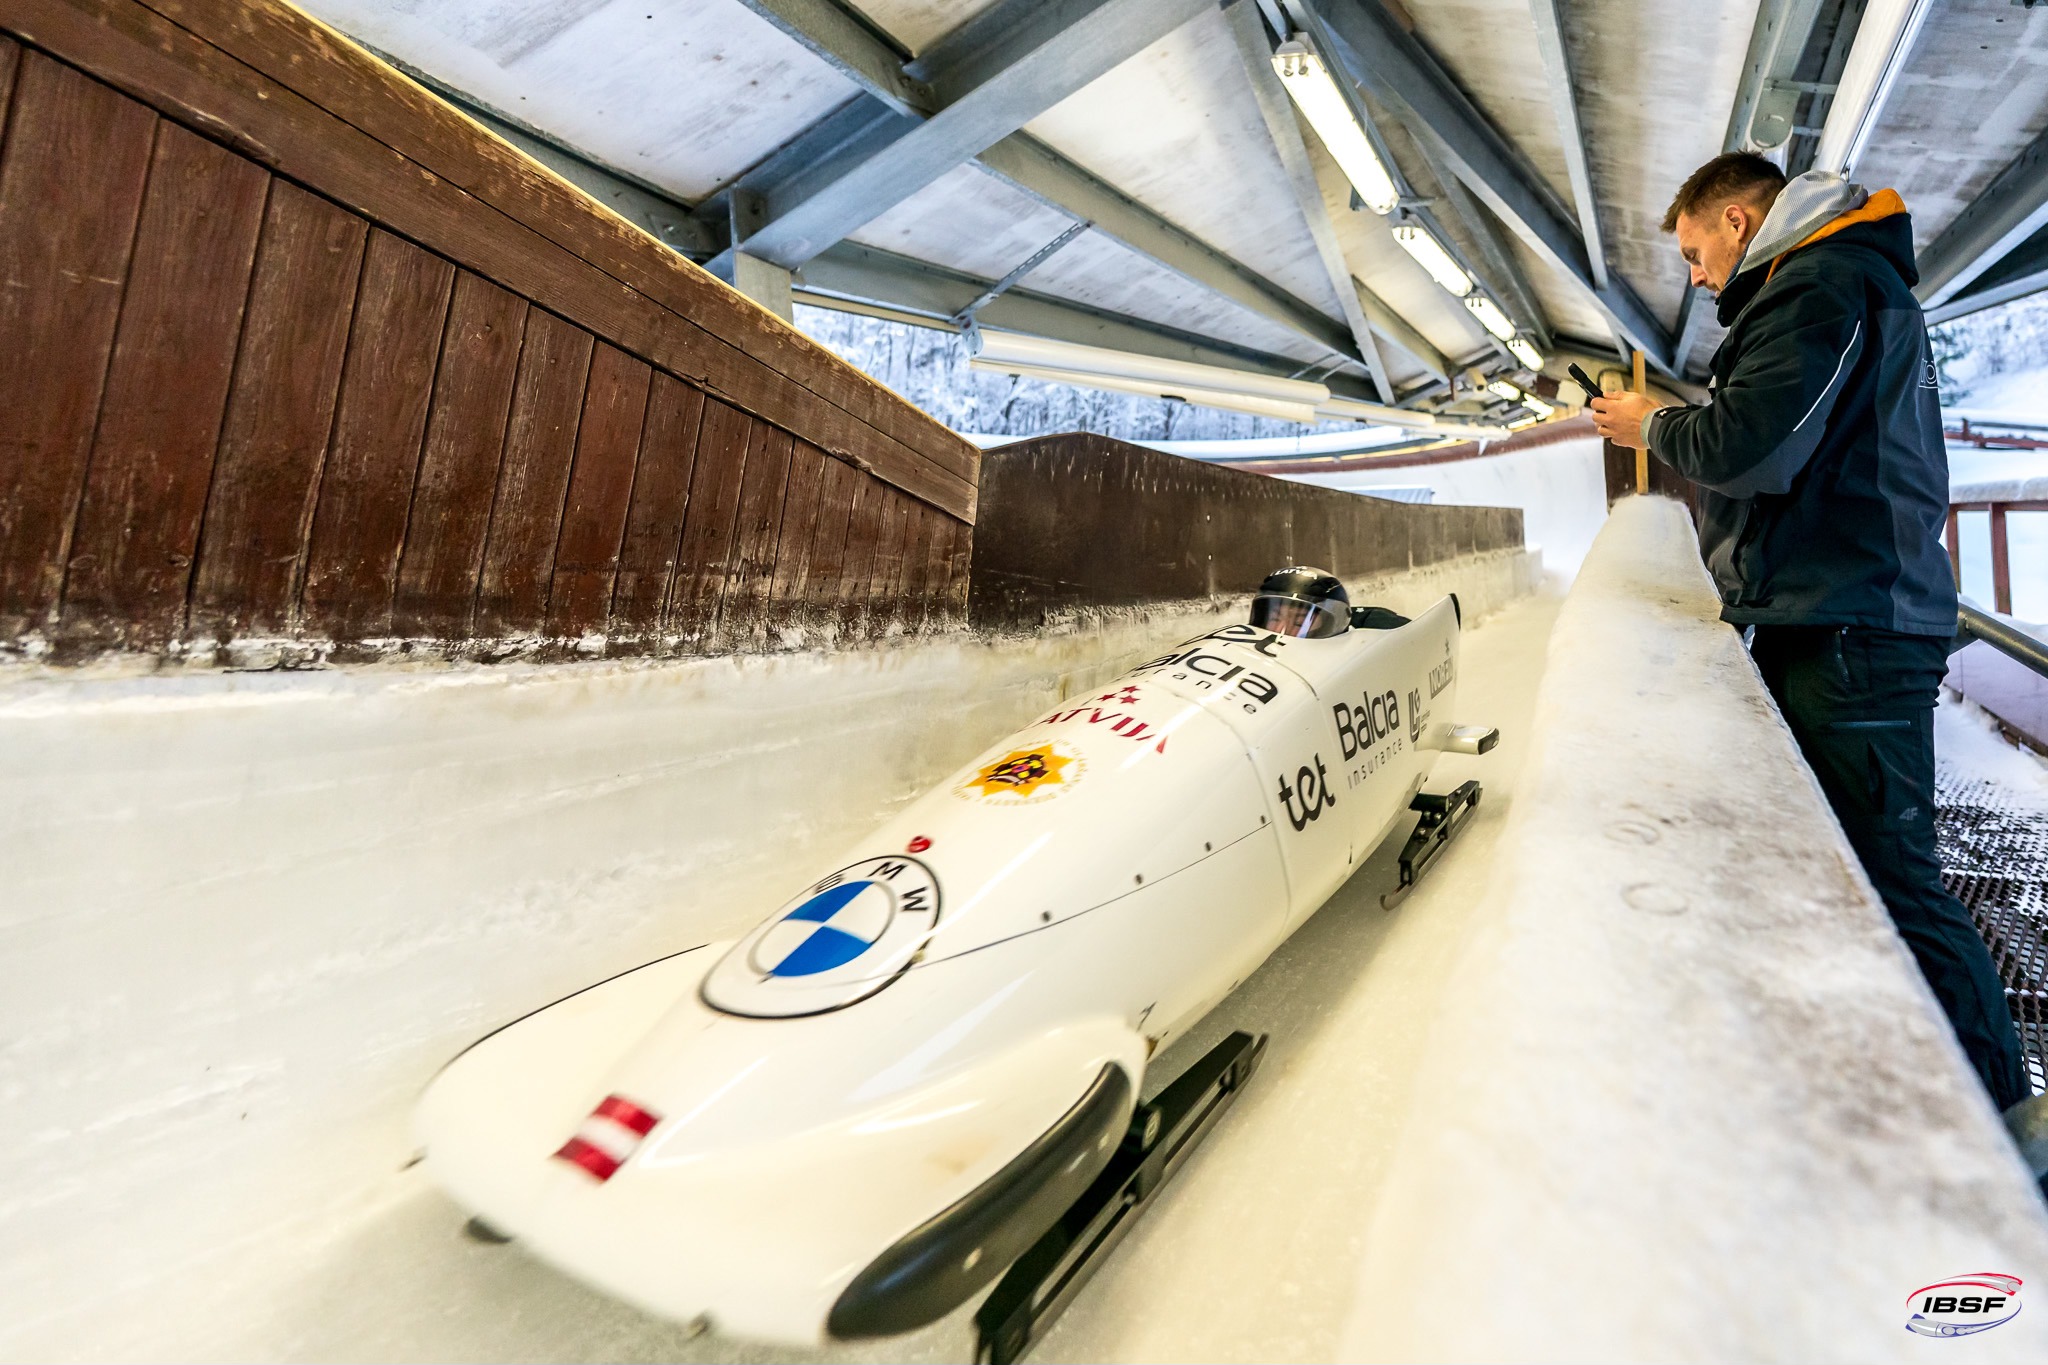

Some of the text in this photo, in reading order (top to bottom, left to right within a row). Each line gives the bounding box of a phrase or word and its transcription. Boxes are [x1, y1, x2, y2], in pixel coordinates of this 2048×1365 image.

[1175, 624, 1287, 658] et
[1118, 647, 1278, 705] alcia
[1018, 708, 1169, 754] ATVIJA
[1333, 689, 1400, 762] Balcia
[1347, 738, 1402, 790] insurance
[1278, 752, 1336, 832] tet
[1899, 807, 1918, 820] 4F
[814, 861, 930, 912] BMW
